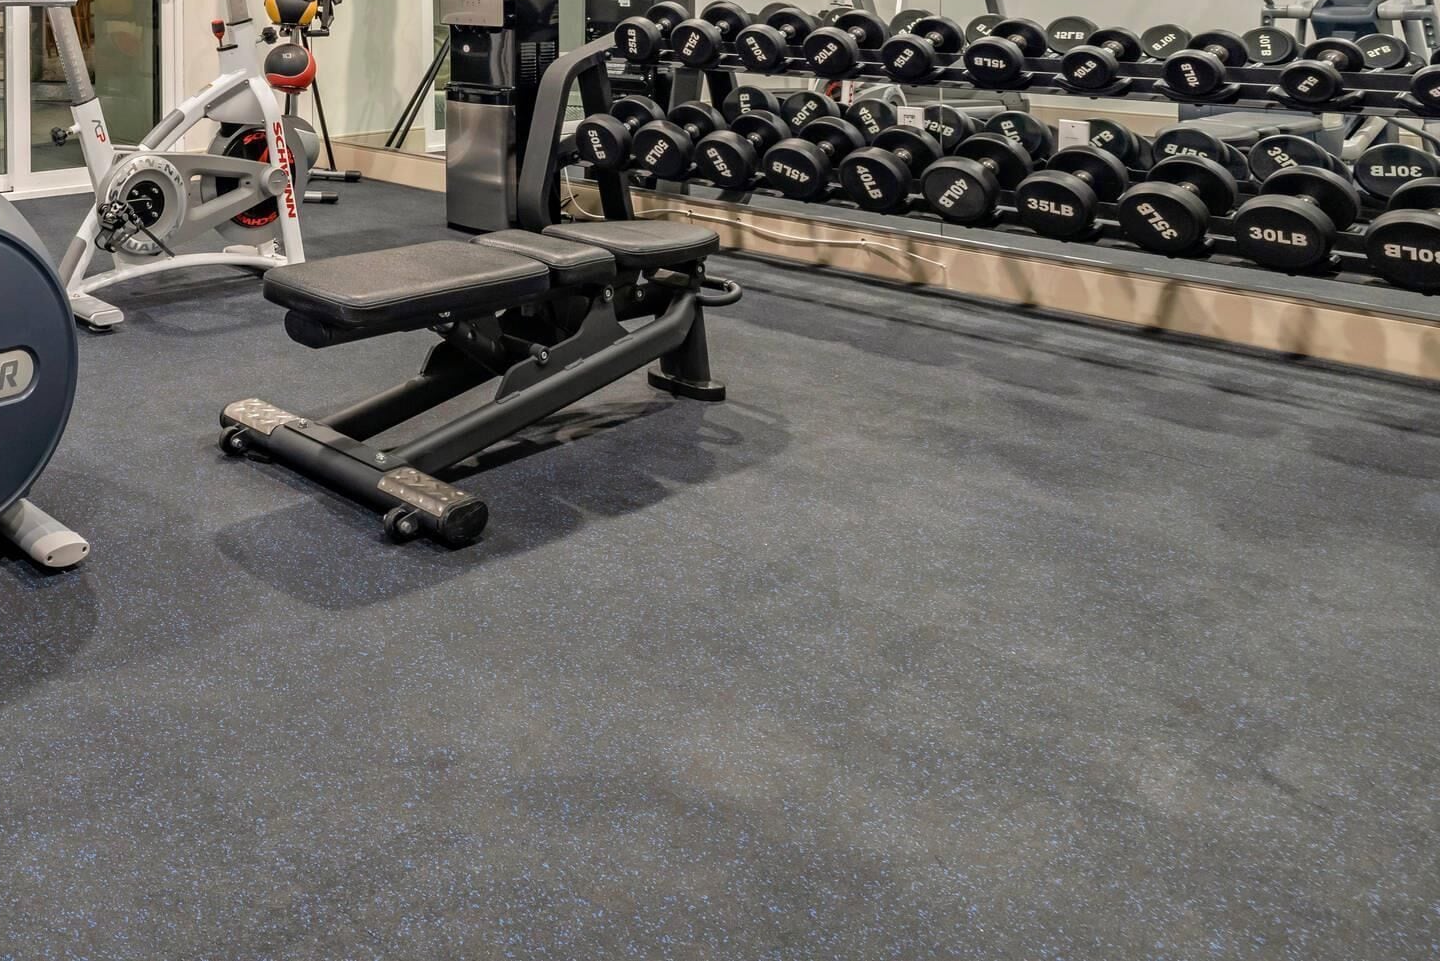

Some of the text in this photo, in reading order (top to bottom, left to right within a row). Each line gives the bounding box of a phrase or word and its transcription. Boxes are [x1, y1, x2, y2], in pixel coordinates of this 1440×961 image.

[627, 28, 638, 54] 25LB
[682, 31, 700, 56] 25LB
[745, 36, 768, 62] 20LB
[813, 42, 838, 65] 20LB
[893, 48, 915, 69] 15LB
[974, 56, 1007, 69] 15LB
[1073, 60, 1097, 79] 10LB
[1180, 63, 1200, 88] 10LB
[1297, 76, 1319, 93] 5LB
[587, 129, 607, 160] 50LB
[645, 139, 669, 166] 50LB
[706, 147, 733, 178] 45LB
[772, 161, 810, 183] 45LB
[855, 164, 884, 200] 40LB
[938, 178, 969, 208] 40LB
[1026, 197, 1075, 217] 35LB
[1136, 202, 1178, 240] 35LB
[1248, 226, 1309, 247] 30LB
[1383, 243, 1440, 264] 0LB
